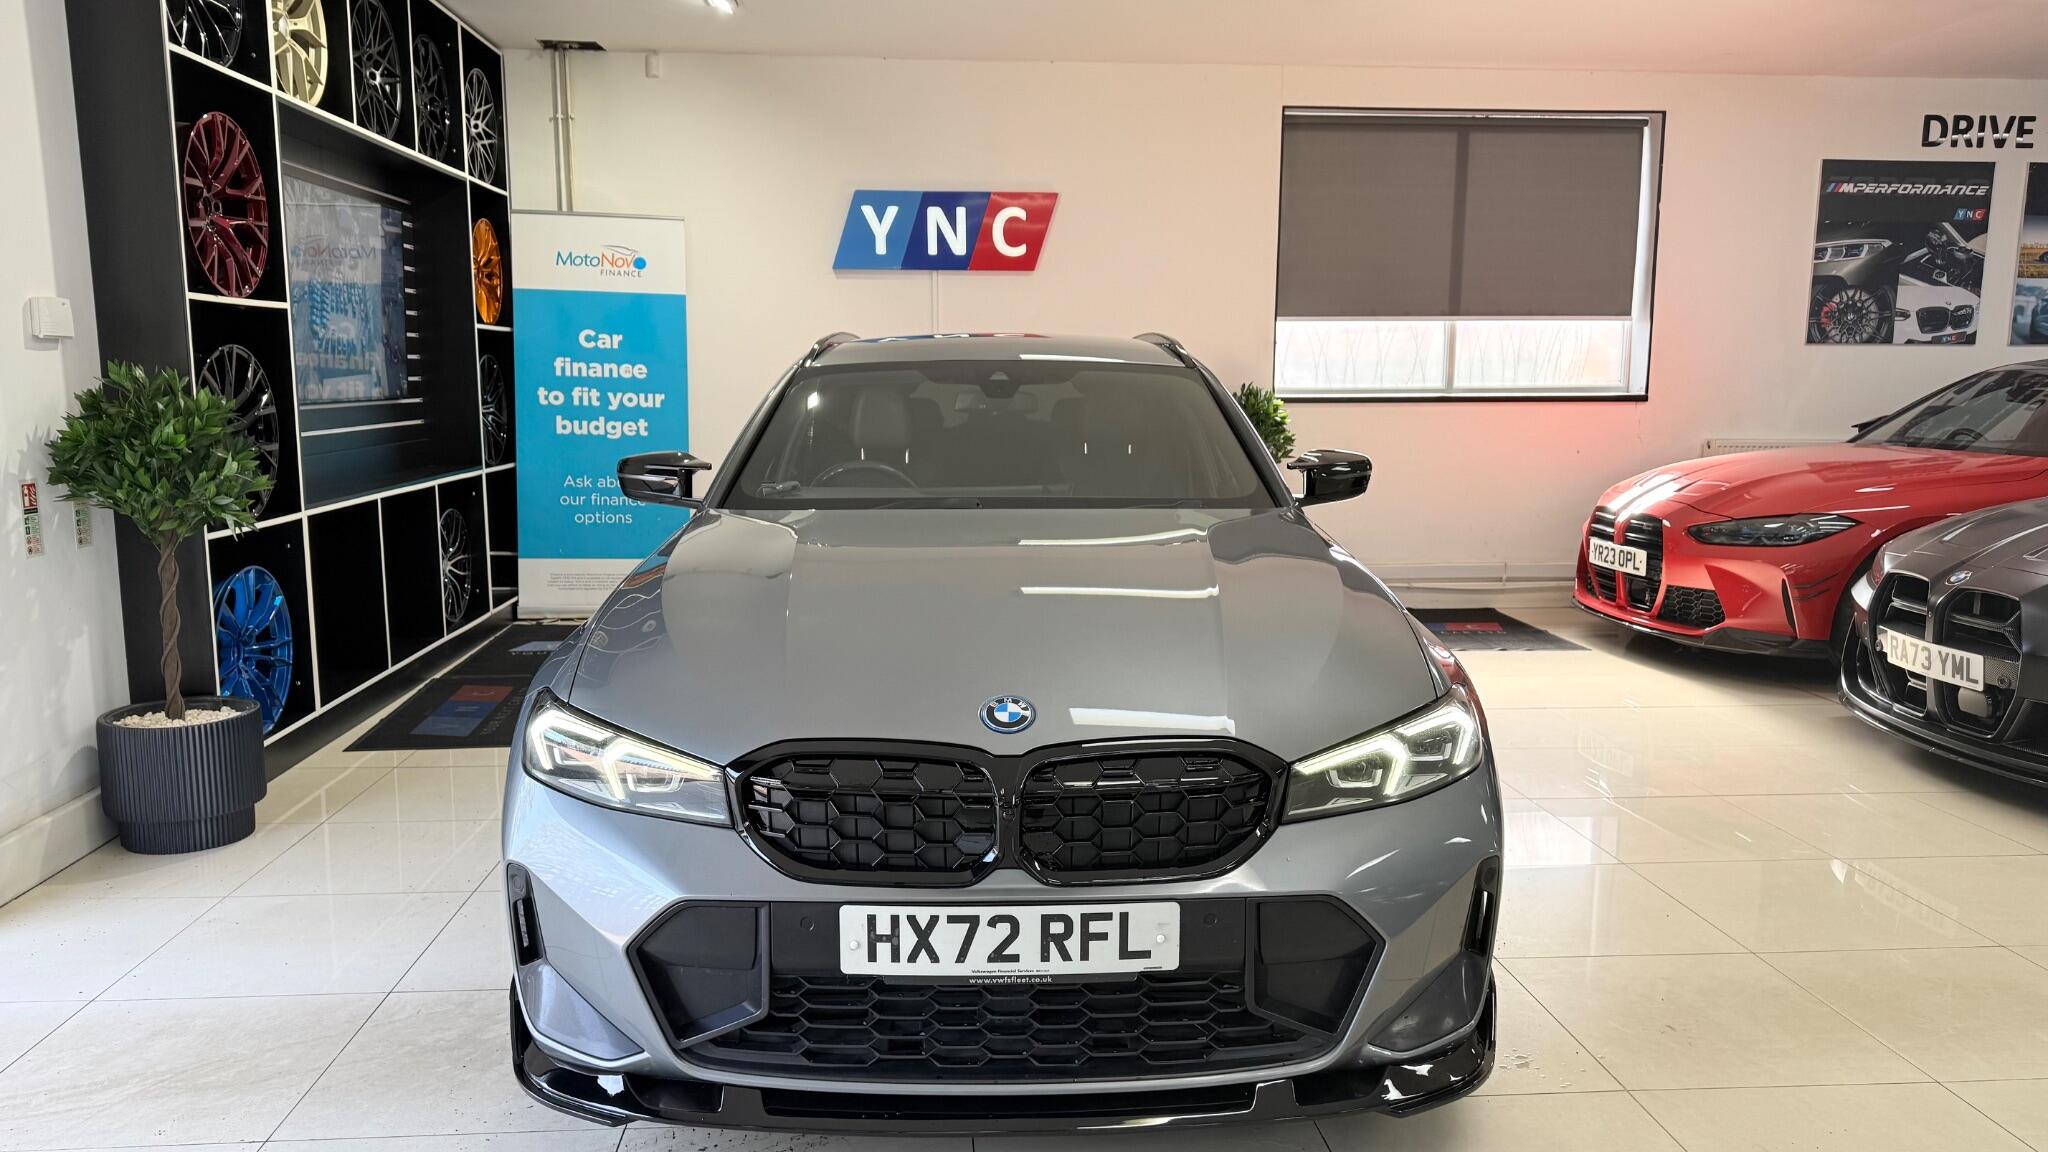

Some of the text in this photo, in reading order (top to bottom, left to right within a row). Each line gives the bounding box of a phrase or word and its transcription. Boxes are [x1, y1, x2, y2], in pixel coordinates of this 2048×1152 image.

[1921, 114, 2037, 149] DRIVE
[1956, 208, 1984, 219] YNC
[860, 204, 1028, 258] YNC
[600, 268, 643, 278] FINANCE
[578, 328, 623, 350] Car
[553, 356, 648, 379] finance
[537, 386, 666, 411] to fit your
[555, 415, 649, 440] budget
[563, 474, 593, 488] Ask
[559, 495, 586, 506] our
[574, 511, 634, 525] options
[1593, 542, 1616, 566] YR23
[1889, 633, 1980, 685] RA73 YML
[866, 911, 1152, 964] HX72 RFL
[968, 975, 1053, 984] www.vwfsfleet.co.uk
